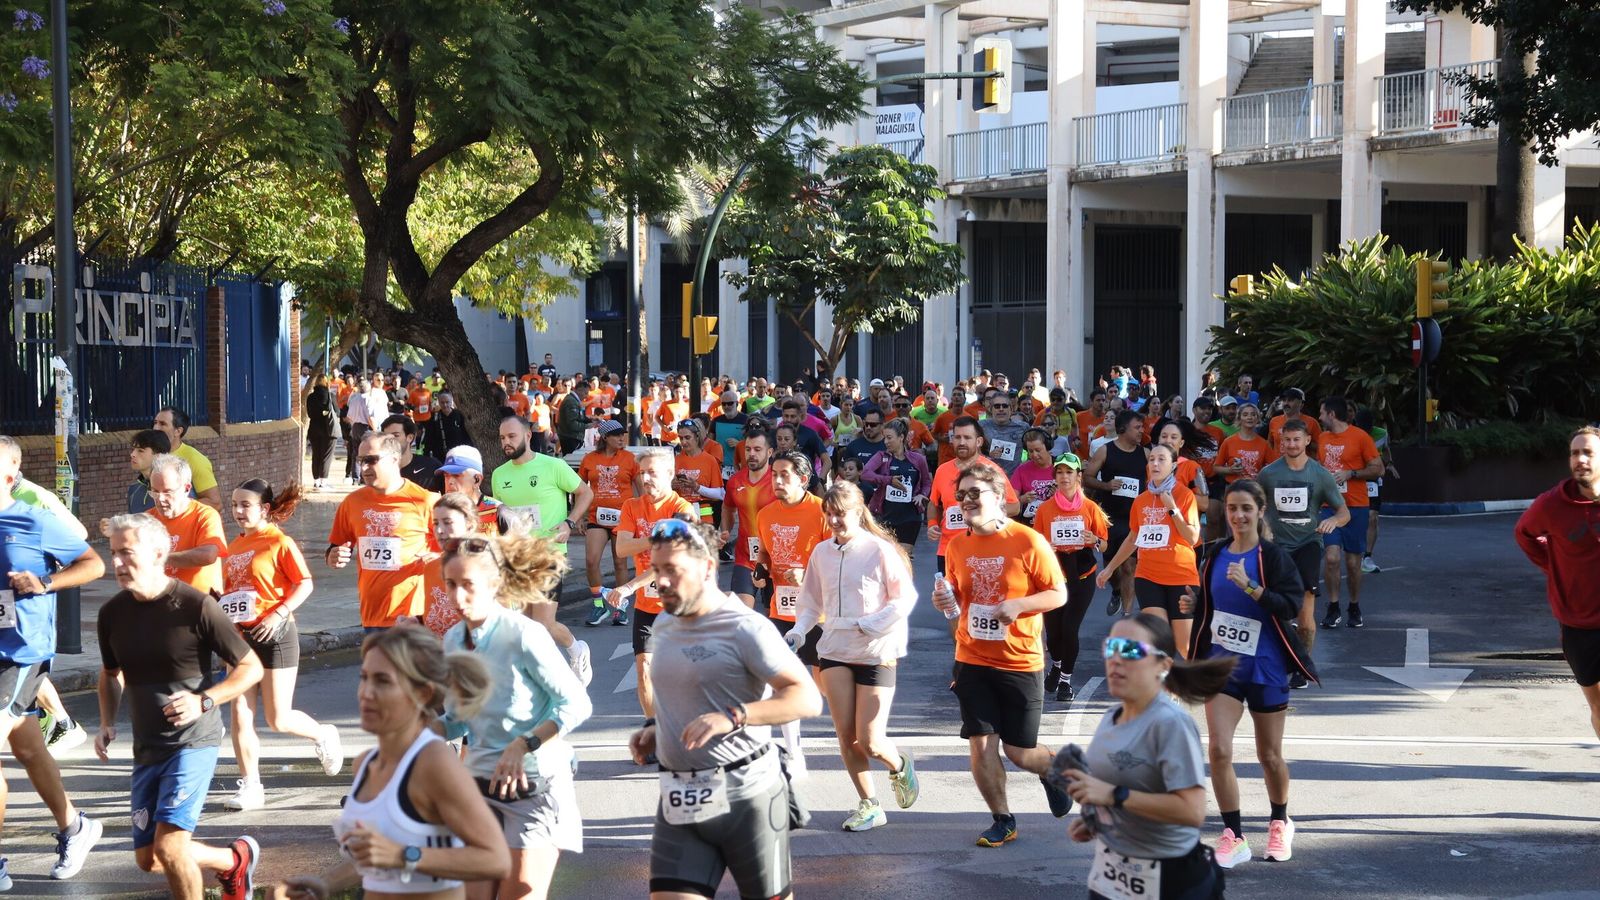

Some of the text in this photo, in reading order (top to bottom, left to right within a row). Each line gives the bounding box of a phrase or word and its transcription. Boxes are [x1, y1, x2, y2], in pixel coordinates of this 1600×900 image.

[904, 112, 916, 122] VIP
[890, 490, 908, 498] 405
[1280, 496, 1301, 504] 979
[600, 514, 617, 522] 955
[1056, 529, 1079, 538] 553
[1142, 533, 1162, 542] 140
[364, 549, 392, 561] 473
[222, 601, 247, 614] 656
[972, 616, 999, 631] 388
[1217, 625, 1250, 643] 630
[669, 788, 713, 807] 652
[1103, 862, 1145, 895] 346
